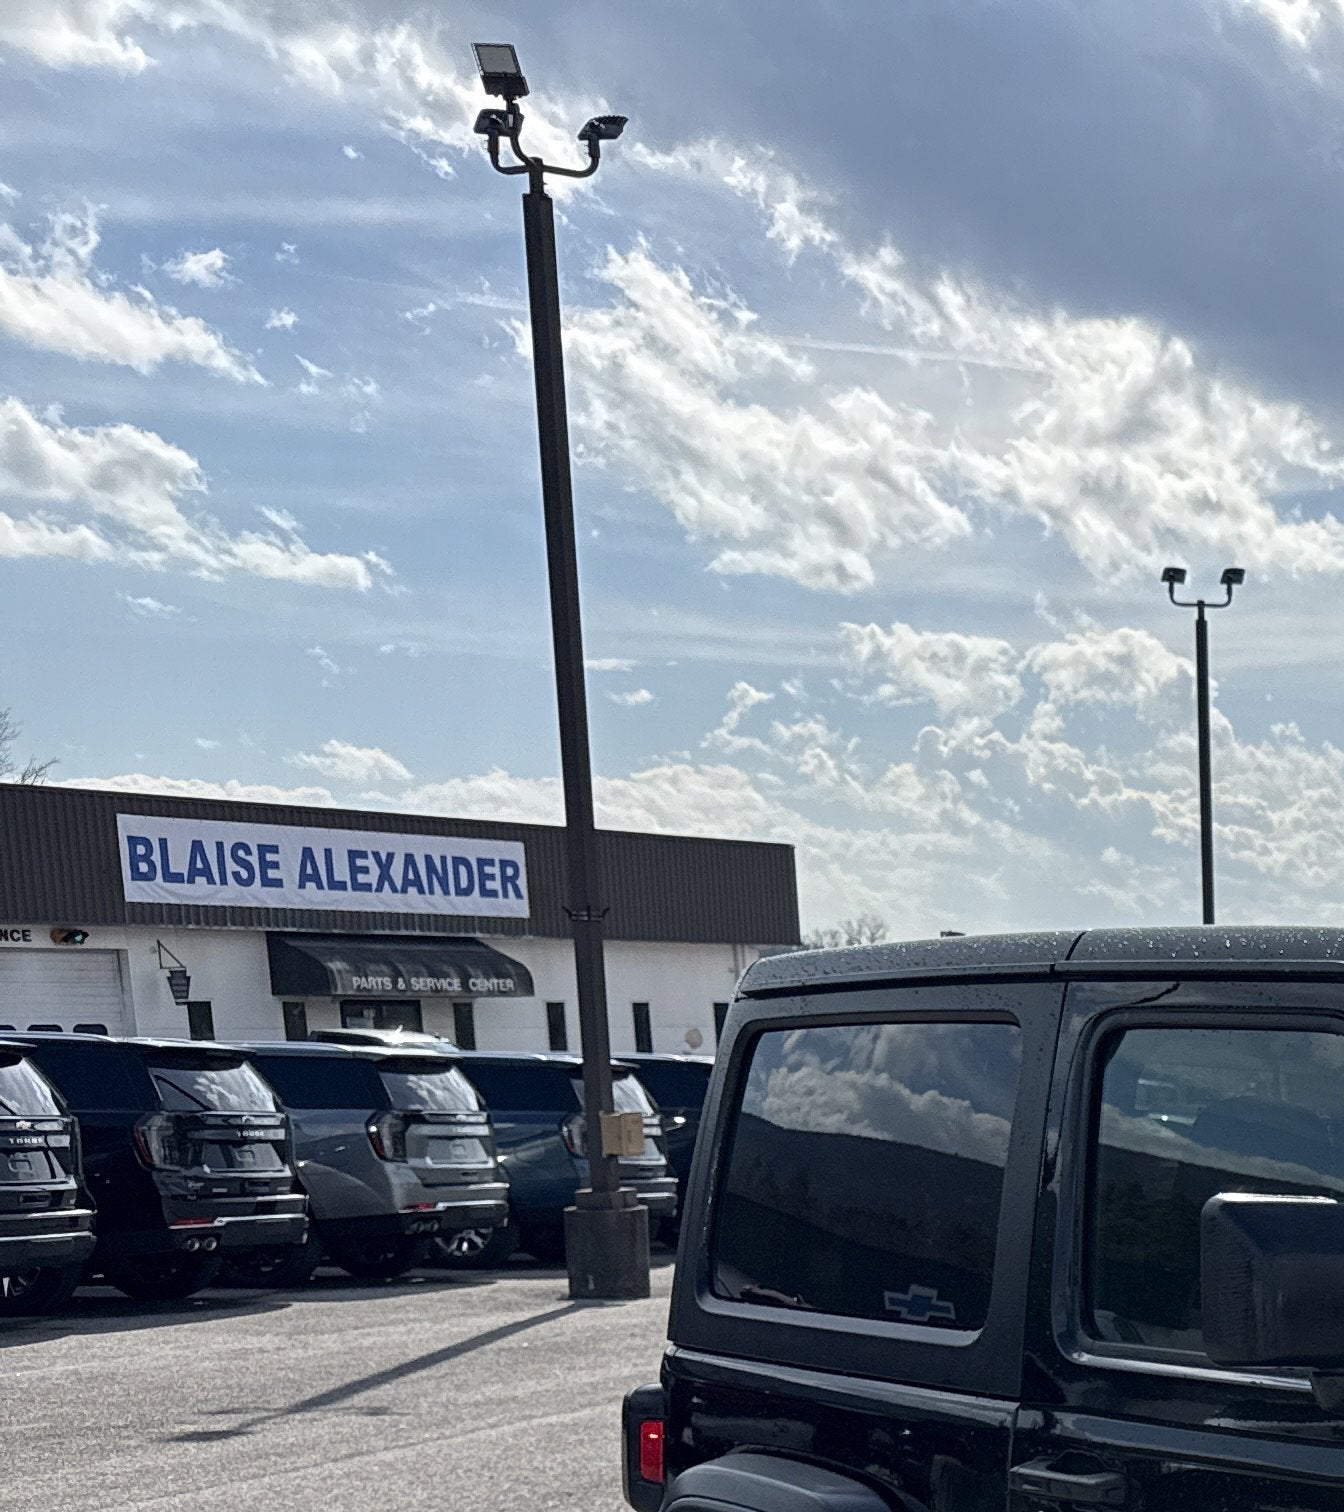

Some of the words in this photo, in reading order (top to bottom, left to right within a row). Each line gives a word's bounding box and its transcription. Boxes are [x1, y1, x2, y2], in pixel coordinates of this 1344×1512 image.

[126, 834, 284, 888] BLAISE
[297, 846, 524, 900] ALEXANDER
[352, 976, 392, 990] PARTS
[397, 977, 406, 990] &
[410, 977, 462, 992] SERVICE
[469, 978, 514, 992] CENTER
